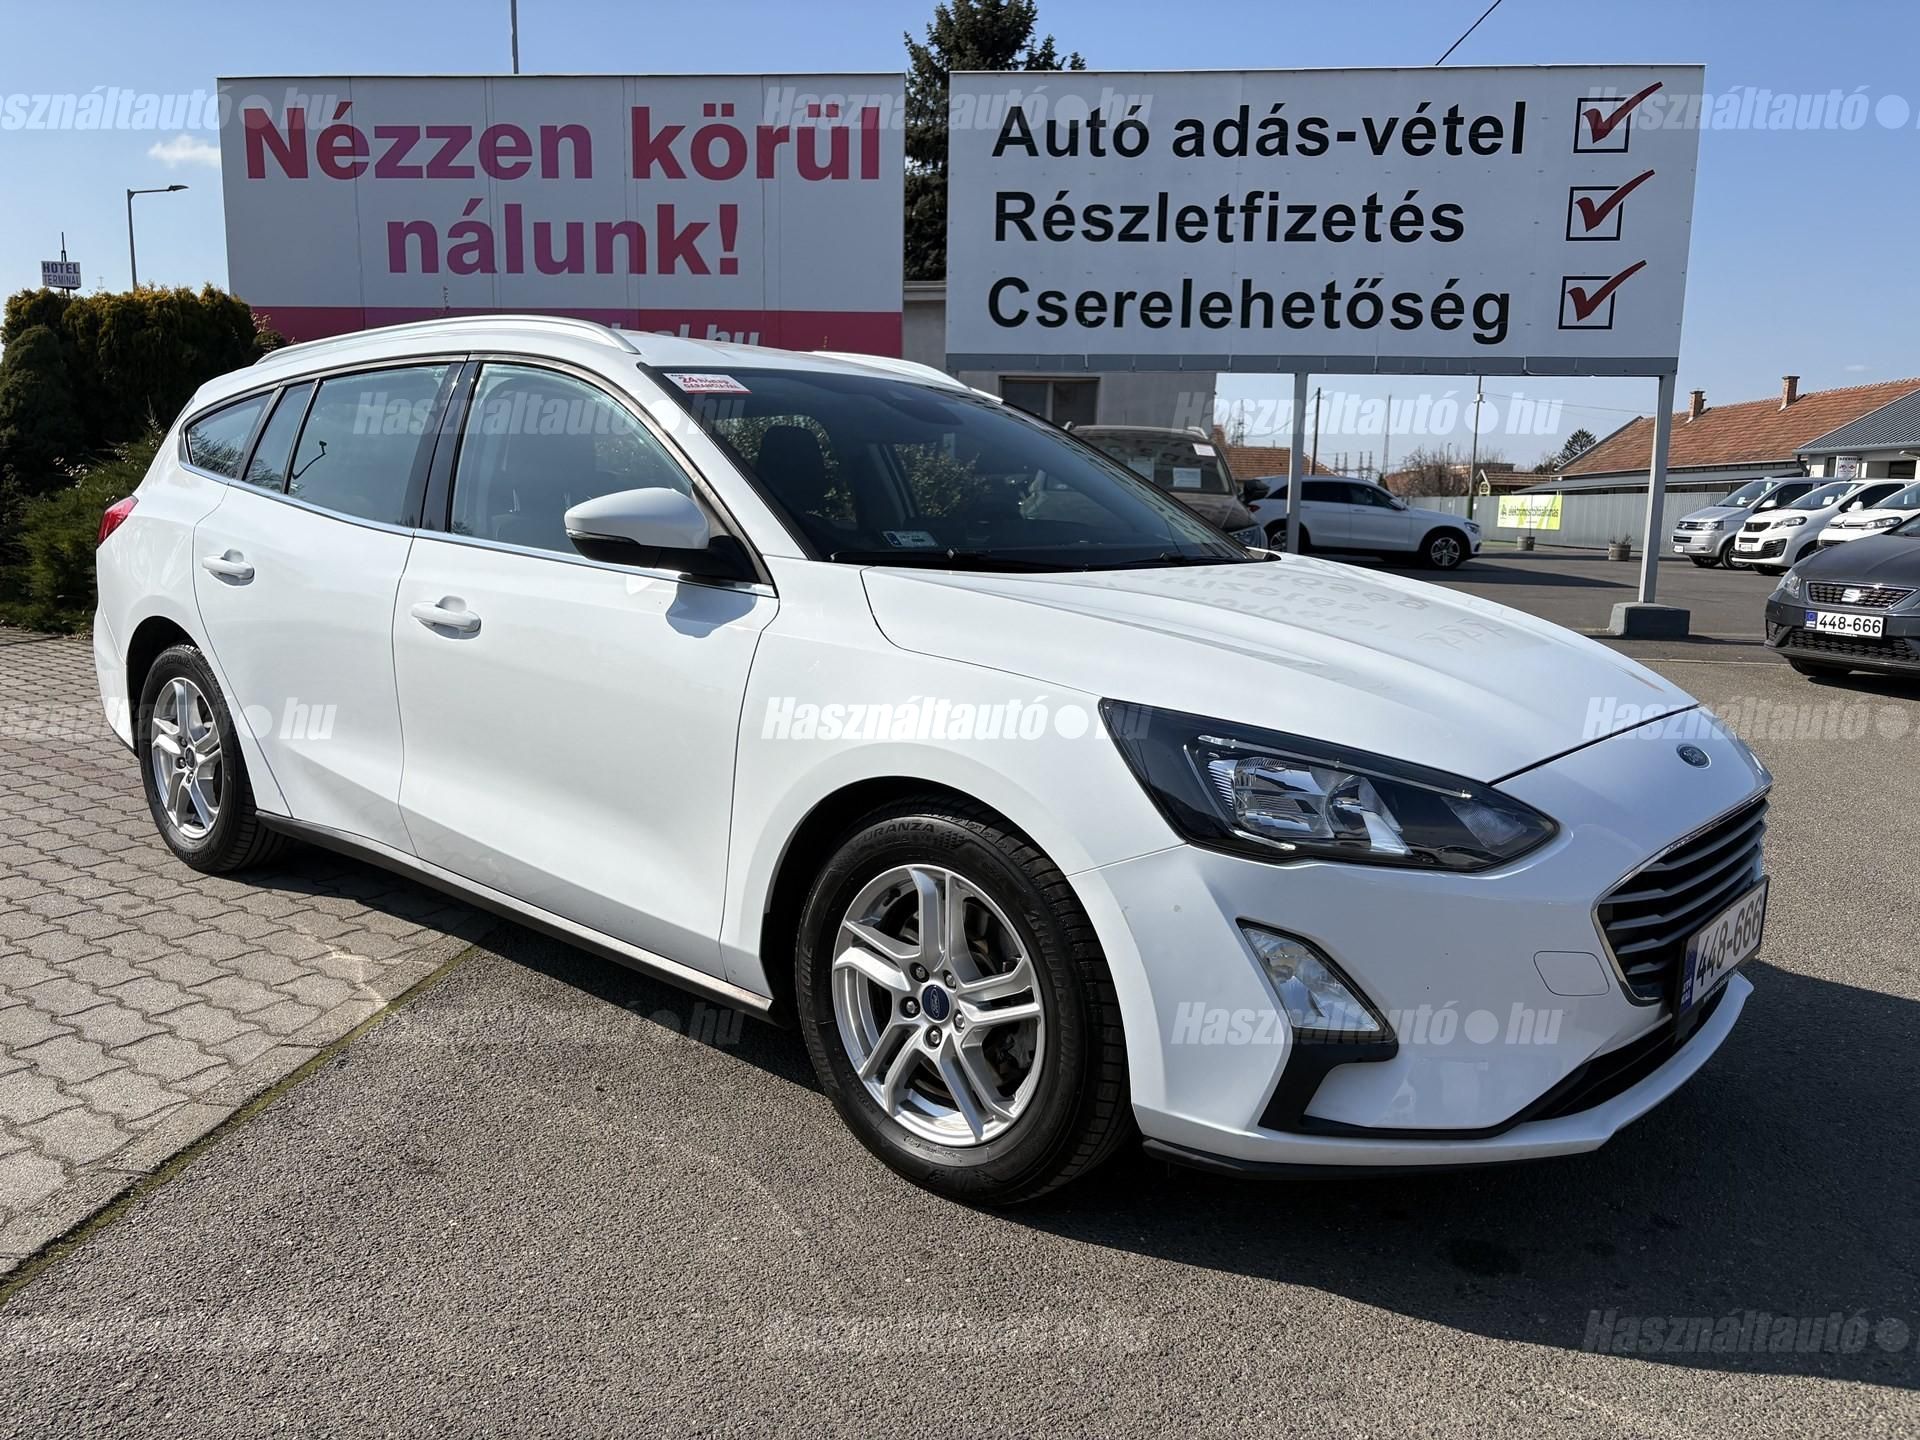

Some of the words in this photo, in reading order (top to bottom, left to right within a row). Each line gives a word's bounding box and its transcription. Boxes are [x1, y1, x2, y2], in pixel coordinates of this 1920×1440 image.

[245, 102, 591, 180] Nézzen
[632, 103, 880, 180] körül
[992, 104, 1149, 158] Autó
[1173, 101, 1526, 158] adás-vétel
[388, 199, 738, 275] nálunk!
[995, 190, 1464, 244] Részletfizetés
[43, 262, 79, 274] HOTEL
[43, 274, 81, 286] TERMINAL
[988, 276, 1510, 345] Cserelehetőség
[1819, 614, 1881, 634] 448-666
[1695, 892, 1763, 987] 448-666
